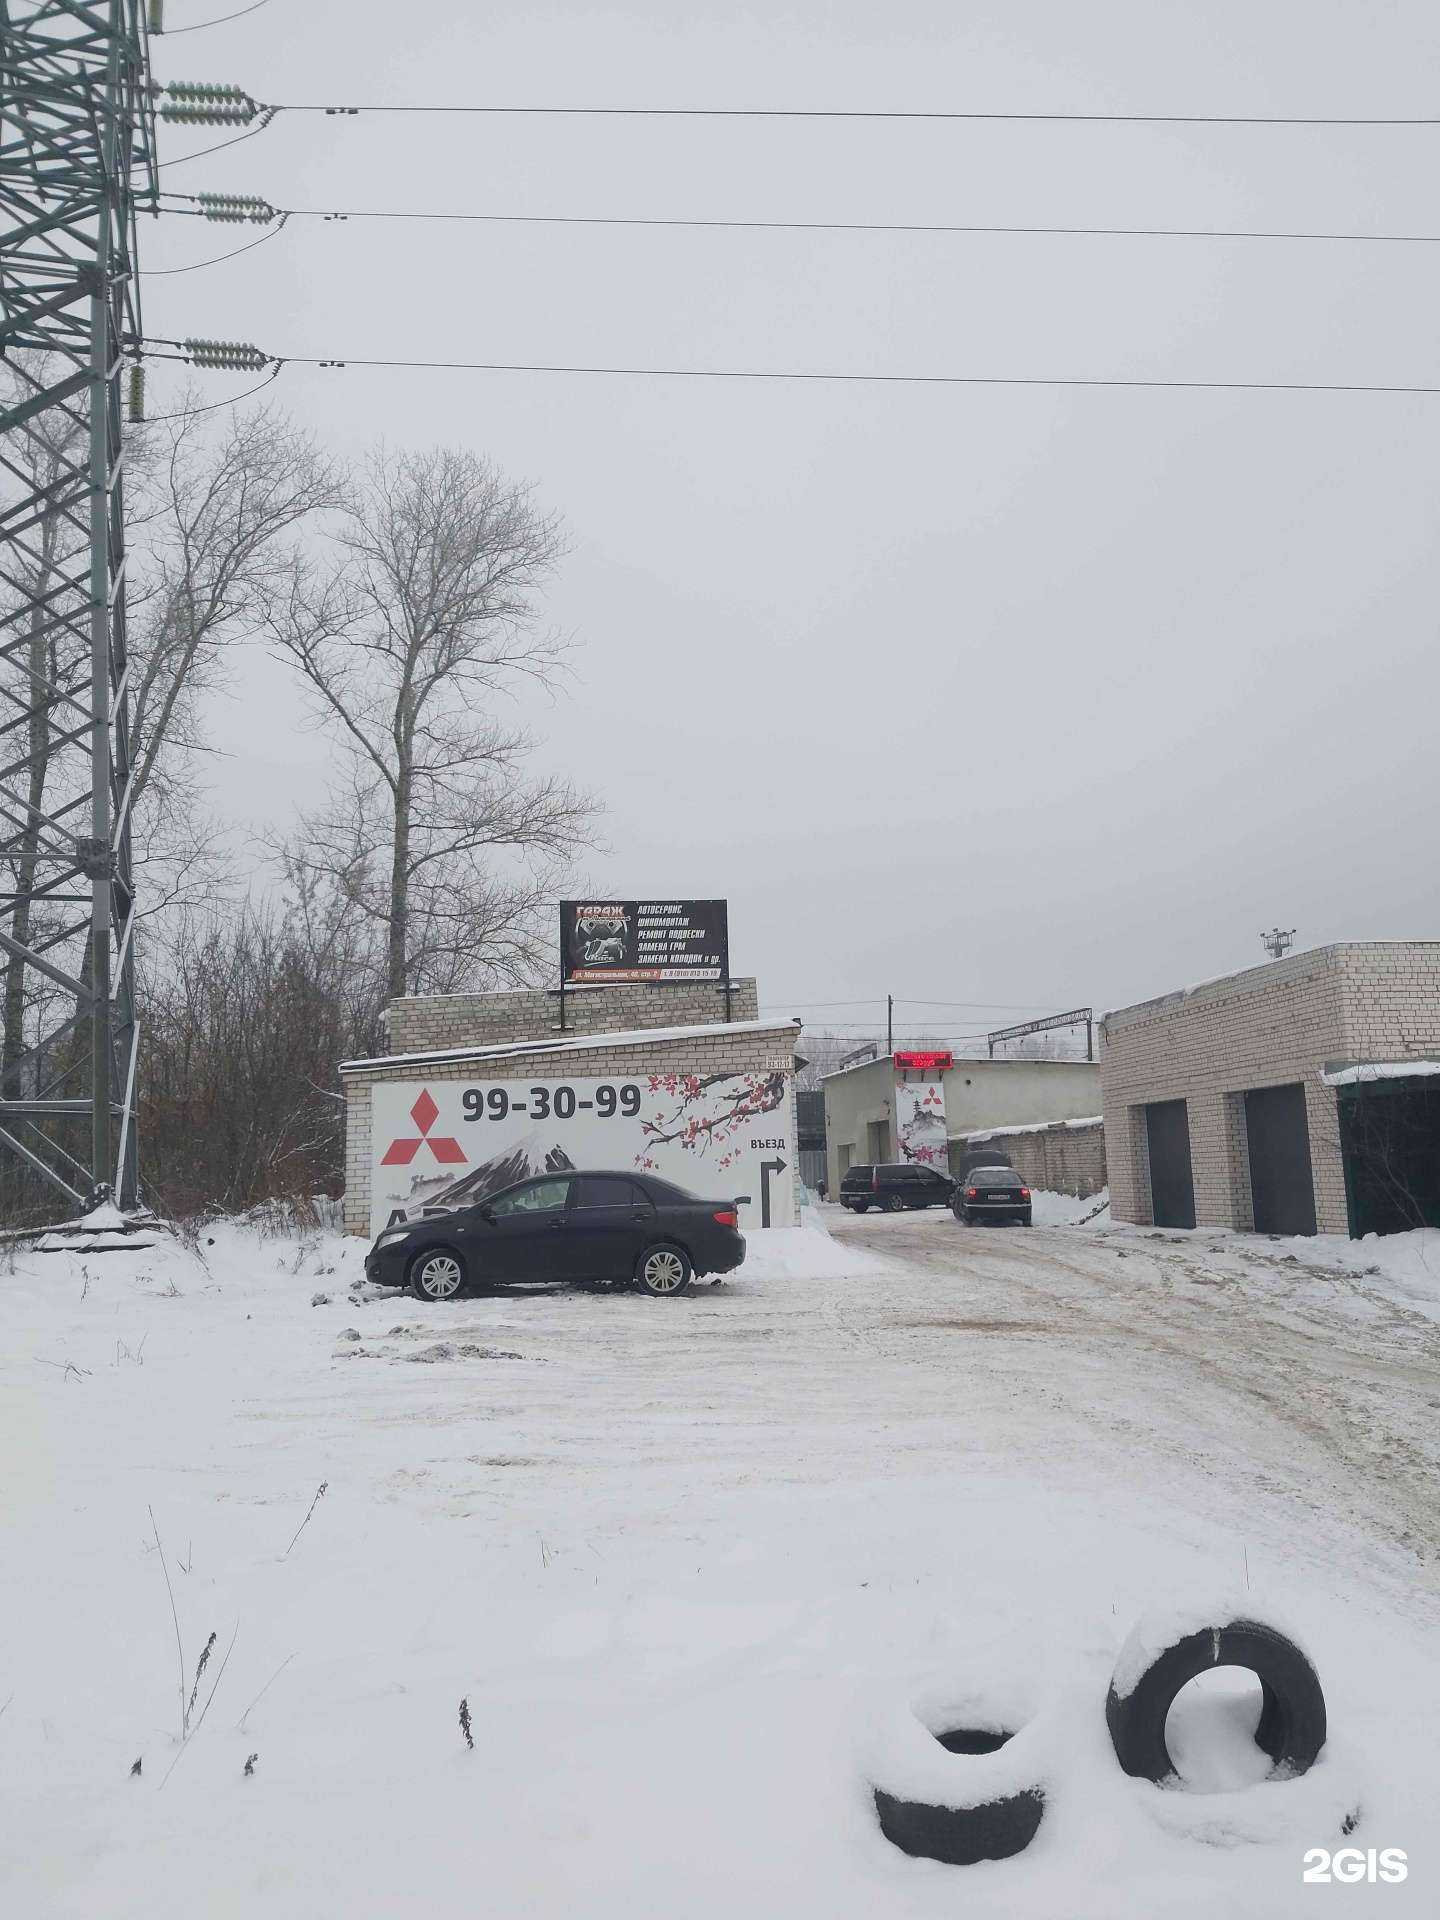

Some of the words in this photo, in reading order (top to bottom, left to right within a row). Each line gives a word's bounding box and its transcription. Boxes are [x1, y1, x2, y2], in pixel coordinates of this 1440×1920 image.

[637, 904, 683, 915] АВТОСЕРВИС
[637, 917, 690, 927] ШИНОМОНТАЖ
[637, 929, 667, 939] РЕМОНТ
[668, 929, 706, 940] ПОДВЕСКИ
[637, 942, 668, 952] ЗАМЕНА
[669, 941, 686, 951] ГРМ
[637, 954, 668, 964] ЗАМЕНА
[669, 953, 703, 964] КОЛОДОК
[710, 955, 721, 965] др.
[462, 1084, 641, 1122] 99-30-99
[750, 1137, 786, 1151] ВЪЕЗД
